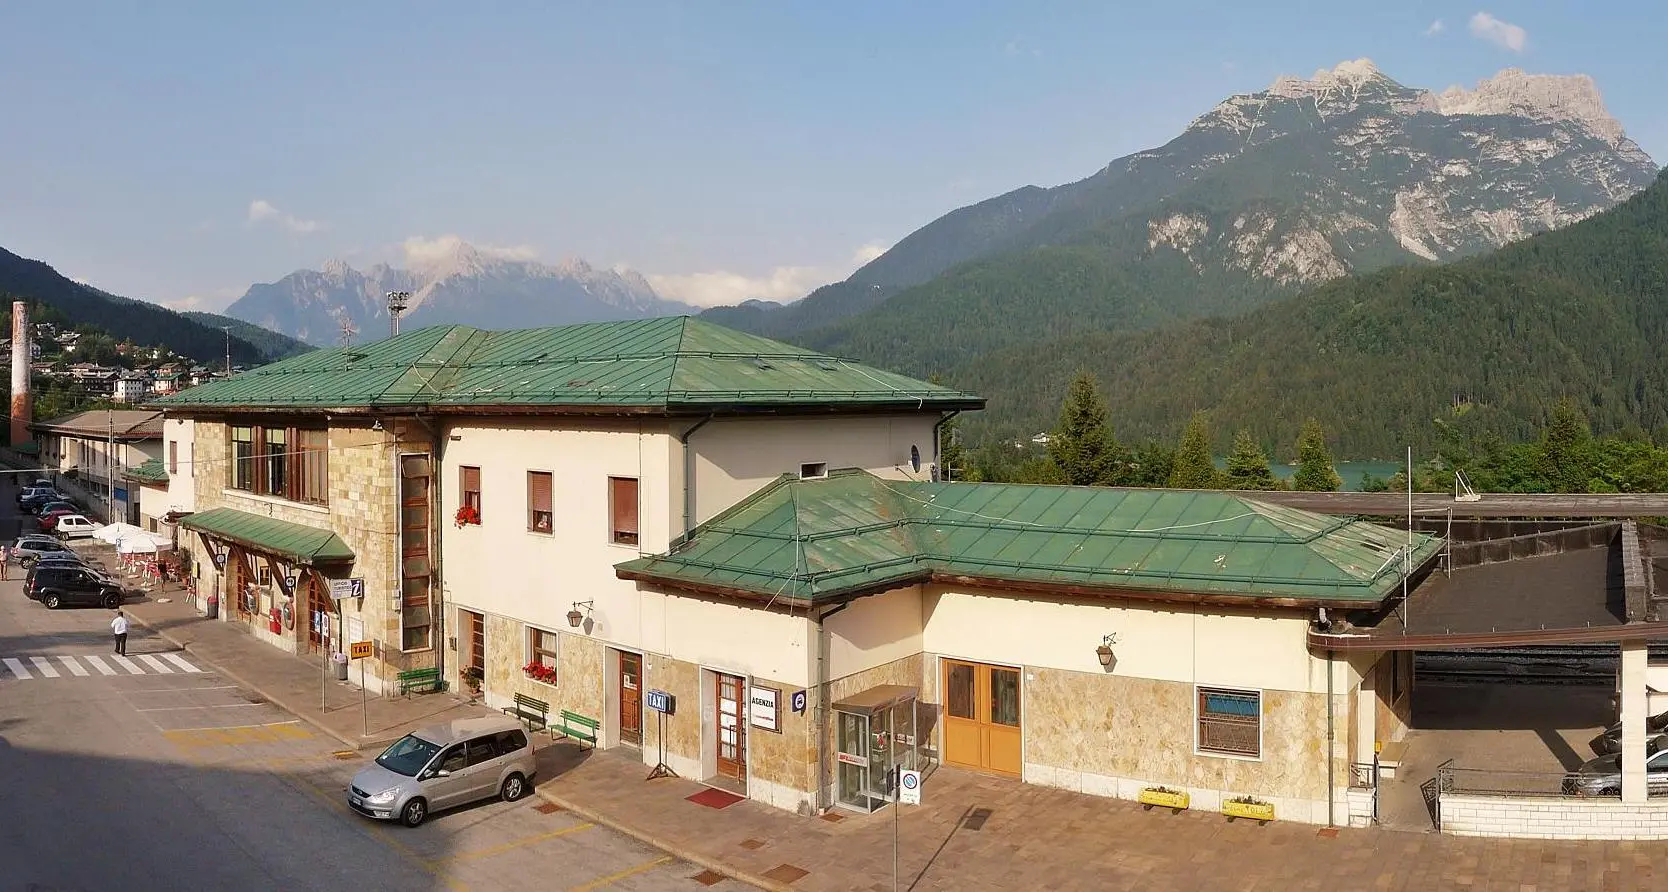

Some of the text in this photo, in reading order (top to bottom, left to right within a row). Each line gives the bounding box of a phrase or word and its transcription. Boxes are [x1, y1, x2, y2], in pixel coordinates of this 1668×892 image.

[354, 646, 370, 654] TAXI
[648, 692, 665, 710] TAXI
[752, 696, 774, 708] AGENZIA
